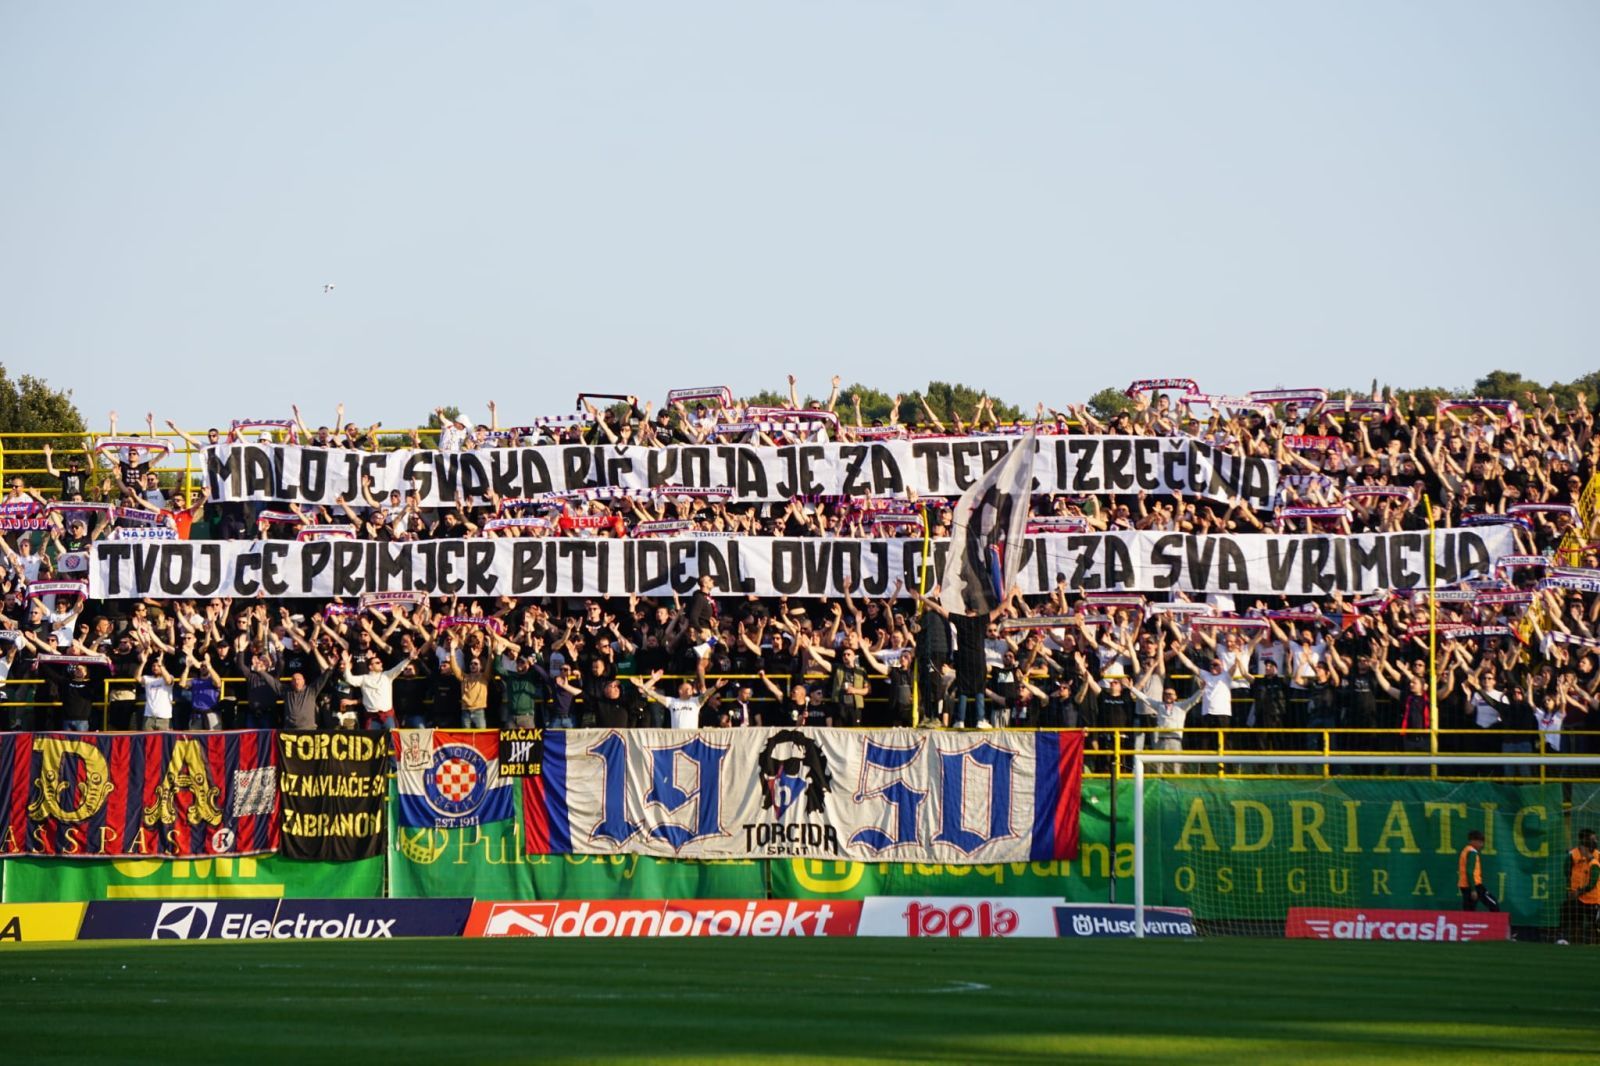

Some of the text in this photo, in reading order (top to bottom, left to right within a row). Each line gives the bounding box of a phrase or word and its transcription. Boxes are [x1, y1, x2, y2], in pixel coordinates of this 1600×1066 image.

[207, 446, 329, 501] MALO
[341, 453, 389, 502] JE
[403, 449, 553, 502] SVAKA
[563, 445, 633, 488] RIČ
[648, 446, 769, 498] KOJA
[776, 446, 825, 498] JE
[840, 444, 904, 495] ZA
[1055, 438, 1270, 507] IZREČENA
[573, 517, 609, 527] TETRA
[97, 543, 221, 596] TVOJ
[234, 541, 289, 596] ĆE
[302, 541, 498, 595] PRIMJER
[512, 541, 609, 594] BITI
[624, 540, 755, 594] IDEAL
[772, 541, 889, 595] OVOJ
[1068, 535, 1135, 590] ZA
[1151, 534, 1249, 590] SVA
[1267, 531, 1490, 593] VRIMENA
[280, 733, 386, 761] TORCIDA
[501, 727, 542, 741] MAČAK
[301, 771, 371, 798] NAVIJAČE
[743, 823, 838, 856] TORCIDA
[1174, 797, 1549, 858] ADRIATIC
[767, 846, 809, 856] SPLIT
[1174, 866, 1549, 903] OSIGURAJE
[220, 913, 397, 939] Electrolux
[553, 902, 833, 937] domprojekt
[903, 900, 1019, 937] topla
[1332, 913, 1458, 941] aircash
